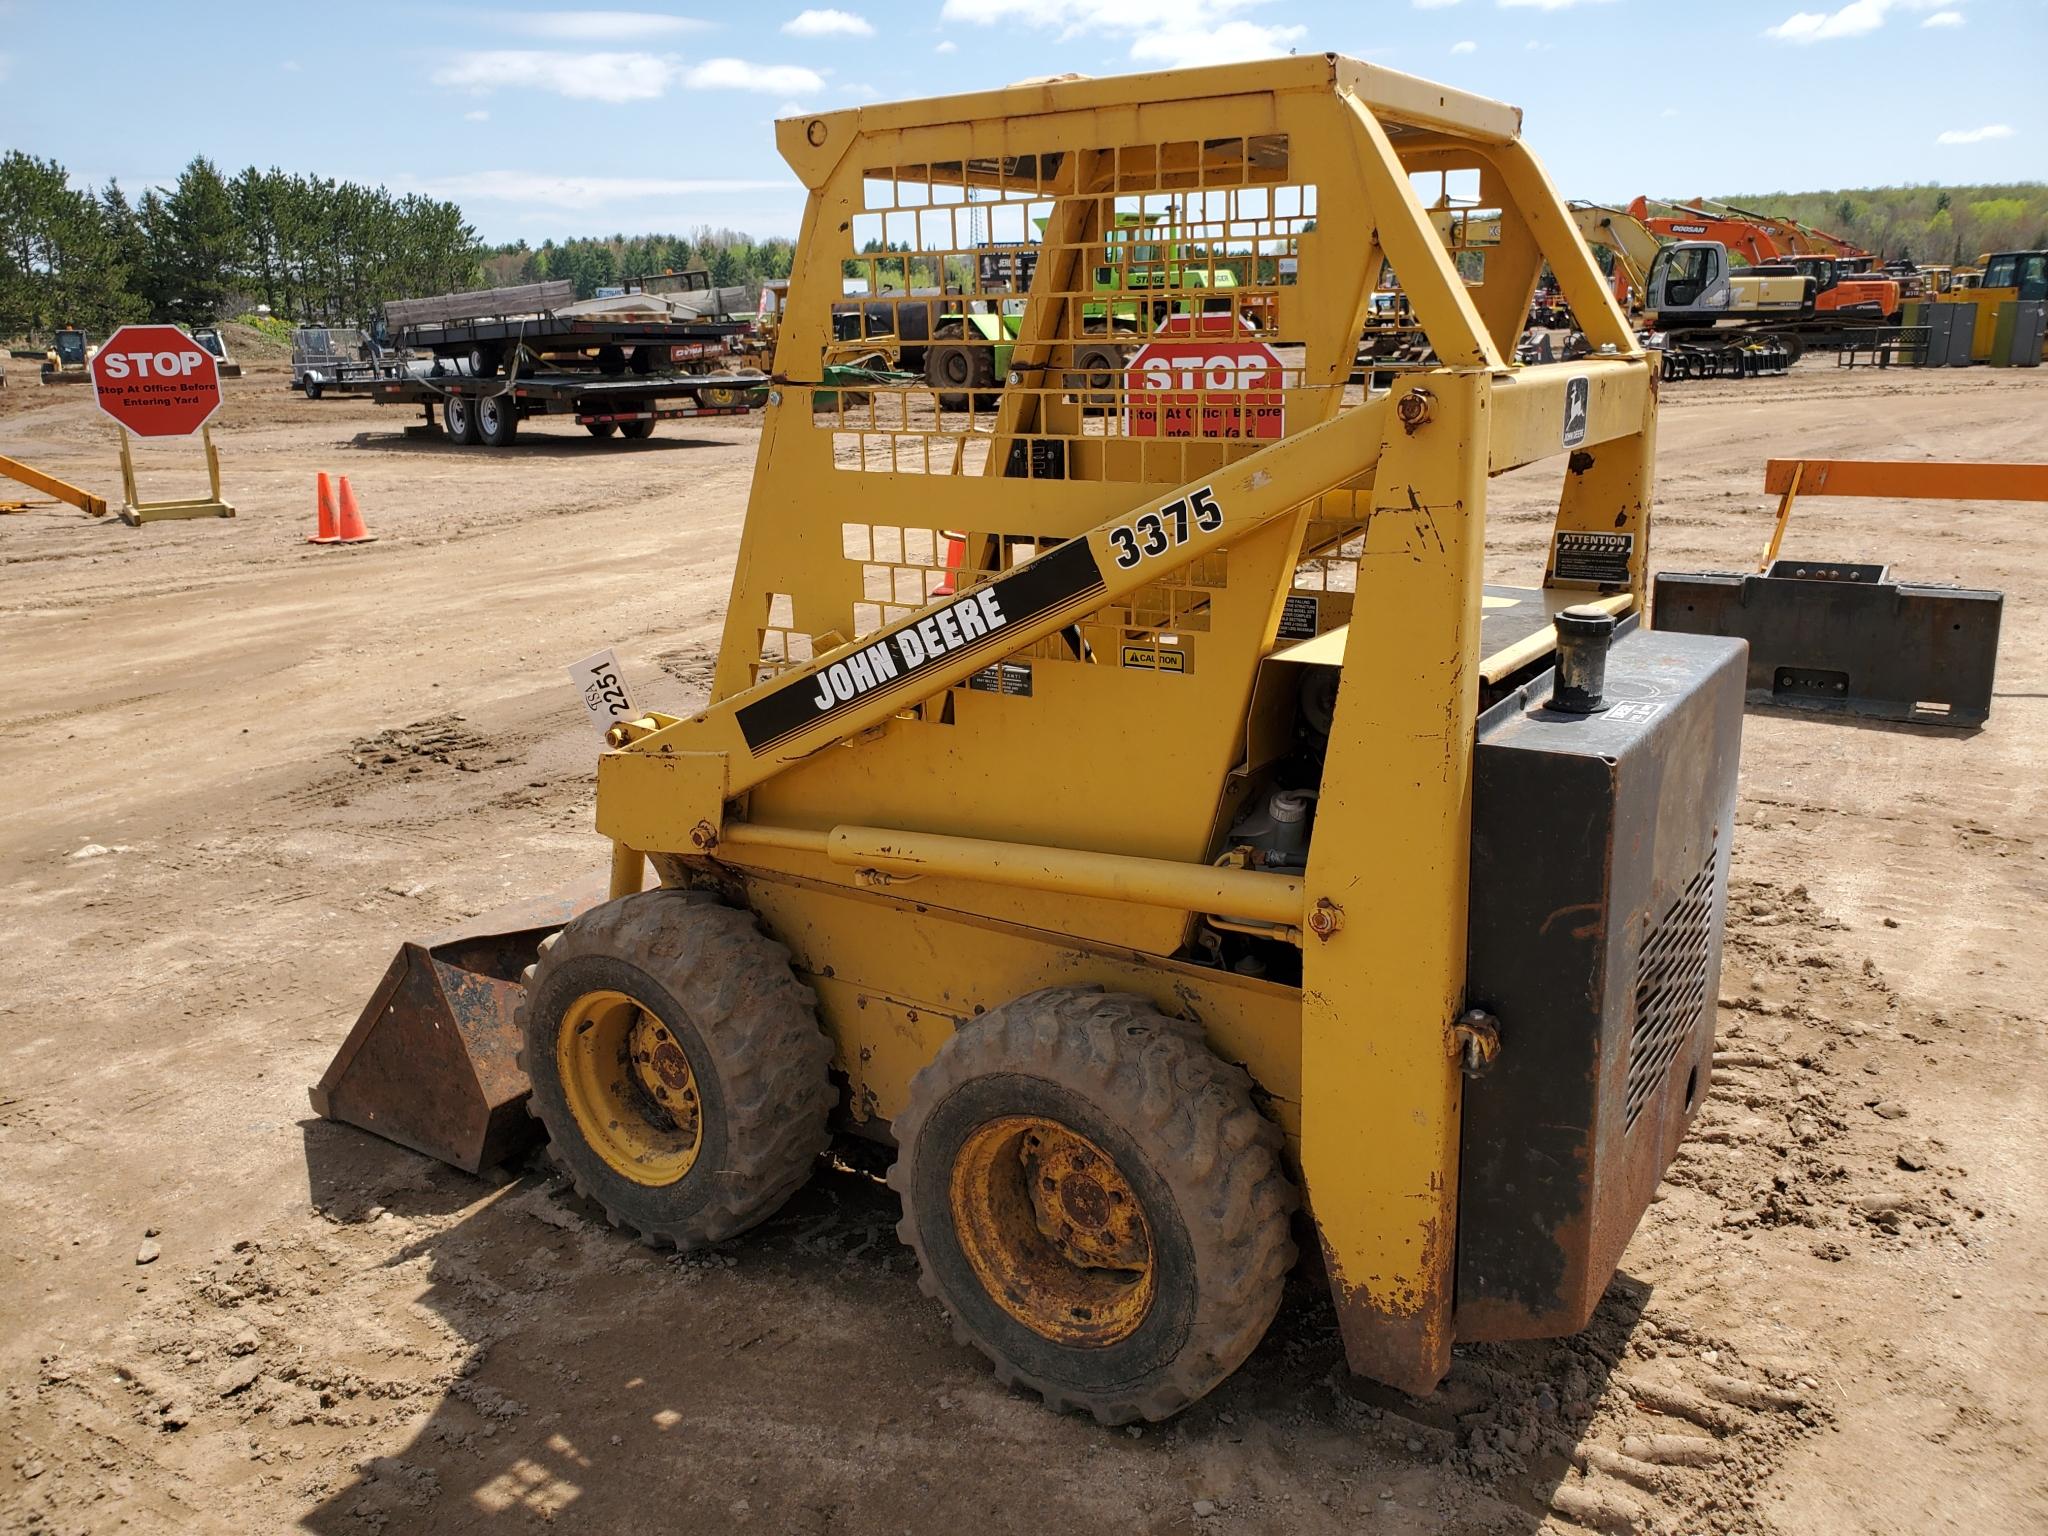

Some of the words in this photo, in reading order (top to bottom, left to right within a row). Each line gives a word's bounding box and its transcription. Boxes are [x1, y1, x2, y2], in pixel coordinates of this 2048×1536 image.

[1672, 225, 1706, 234] DOOSAN
[104, 351, 203, 378] STOP
[1142, 355, 1268, 390] STOP
[98, 385, 124, 396] Stop
[128, 385, 140, 393] At
[143, 384, 176, 393] Office
[180, 383, 216, 392] Before
[123, 397, 171, 407] Entering
[174, 396, 199, 405] Yard
[1109, 484, 1224, 570] 3375
[1562, 534, 1626, 546] ATTENTION
[814, 641, 899, 711] JOHN
[895, 586, 1007, 670] DEERE
[590, 662, 630, 715] 2251
